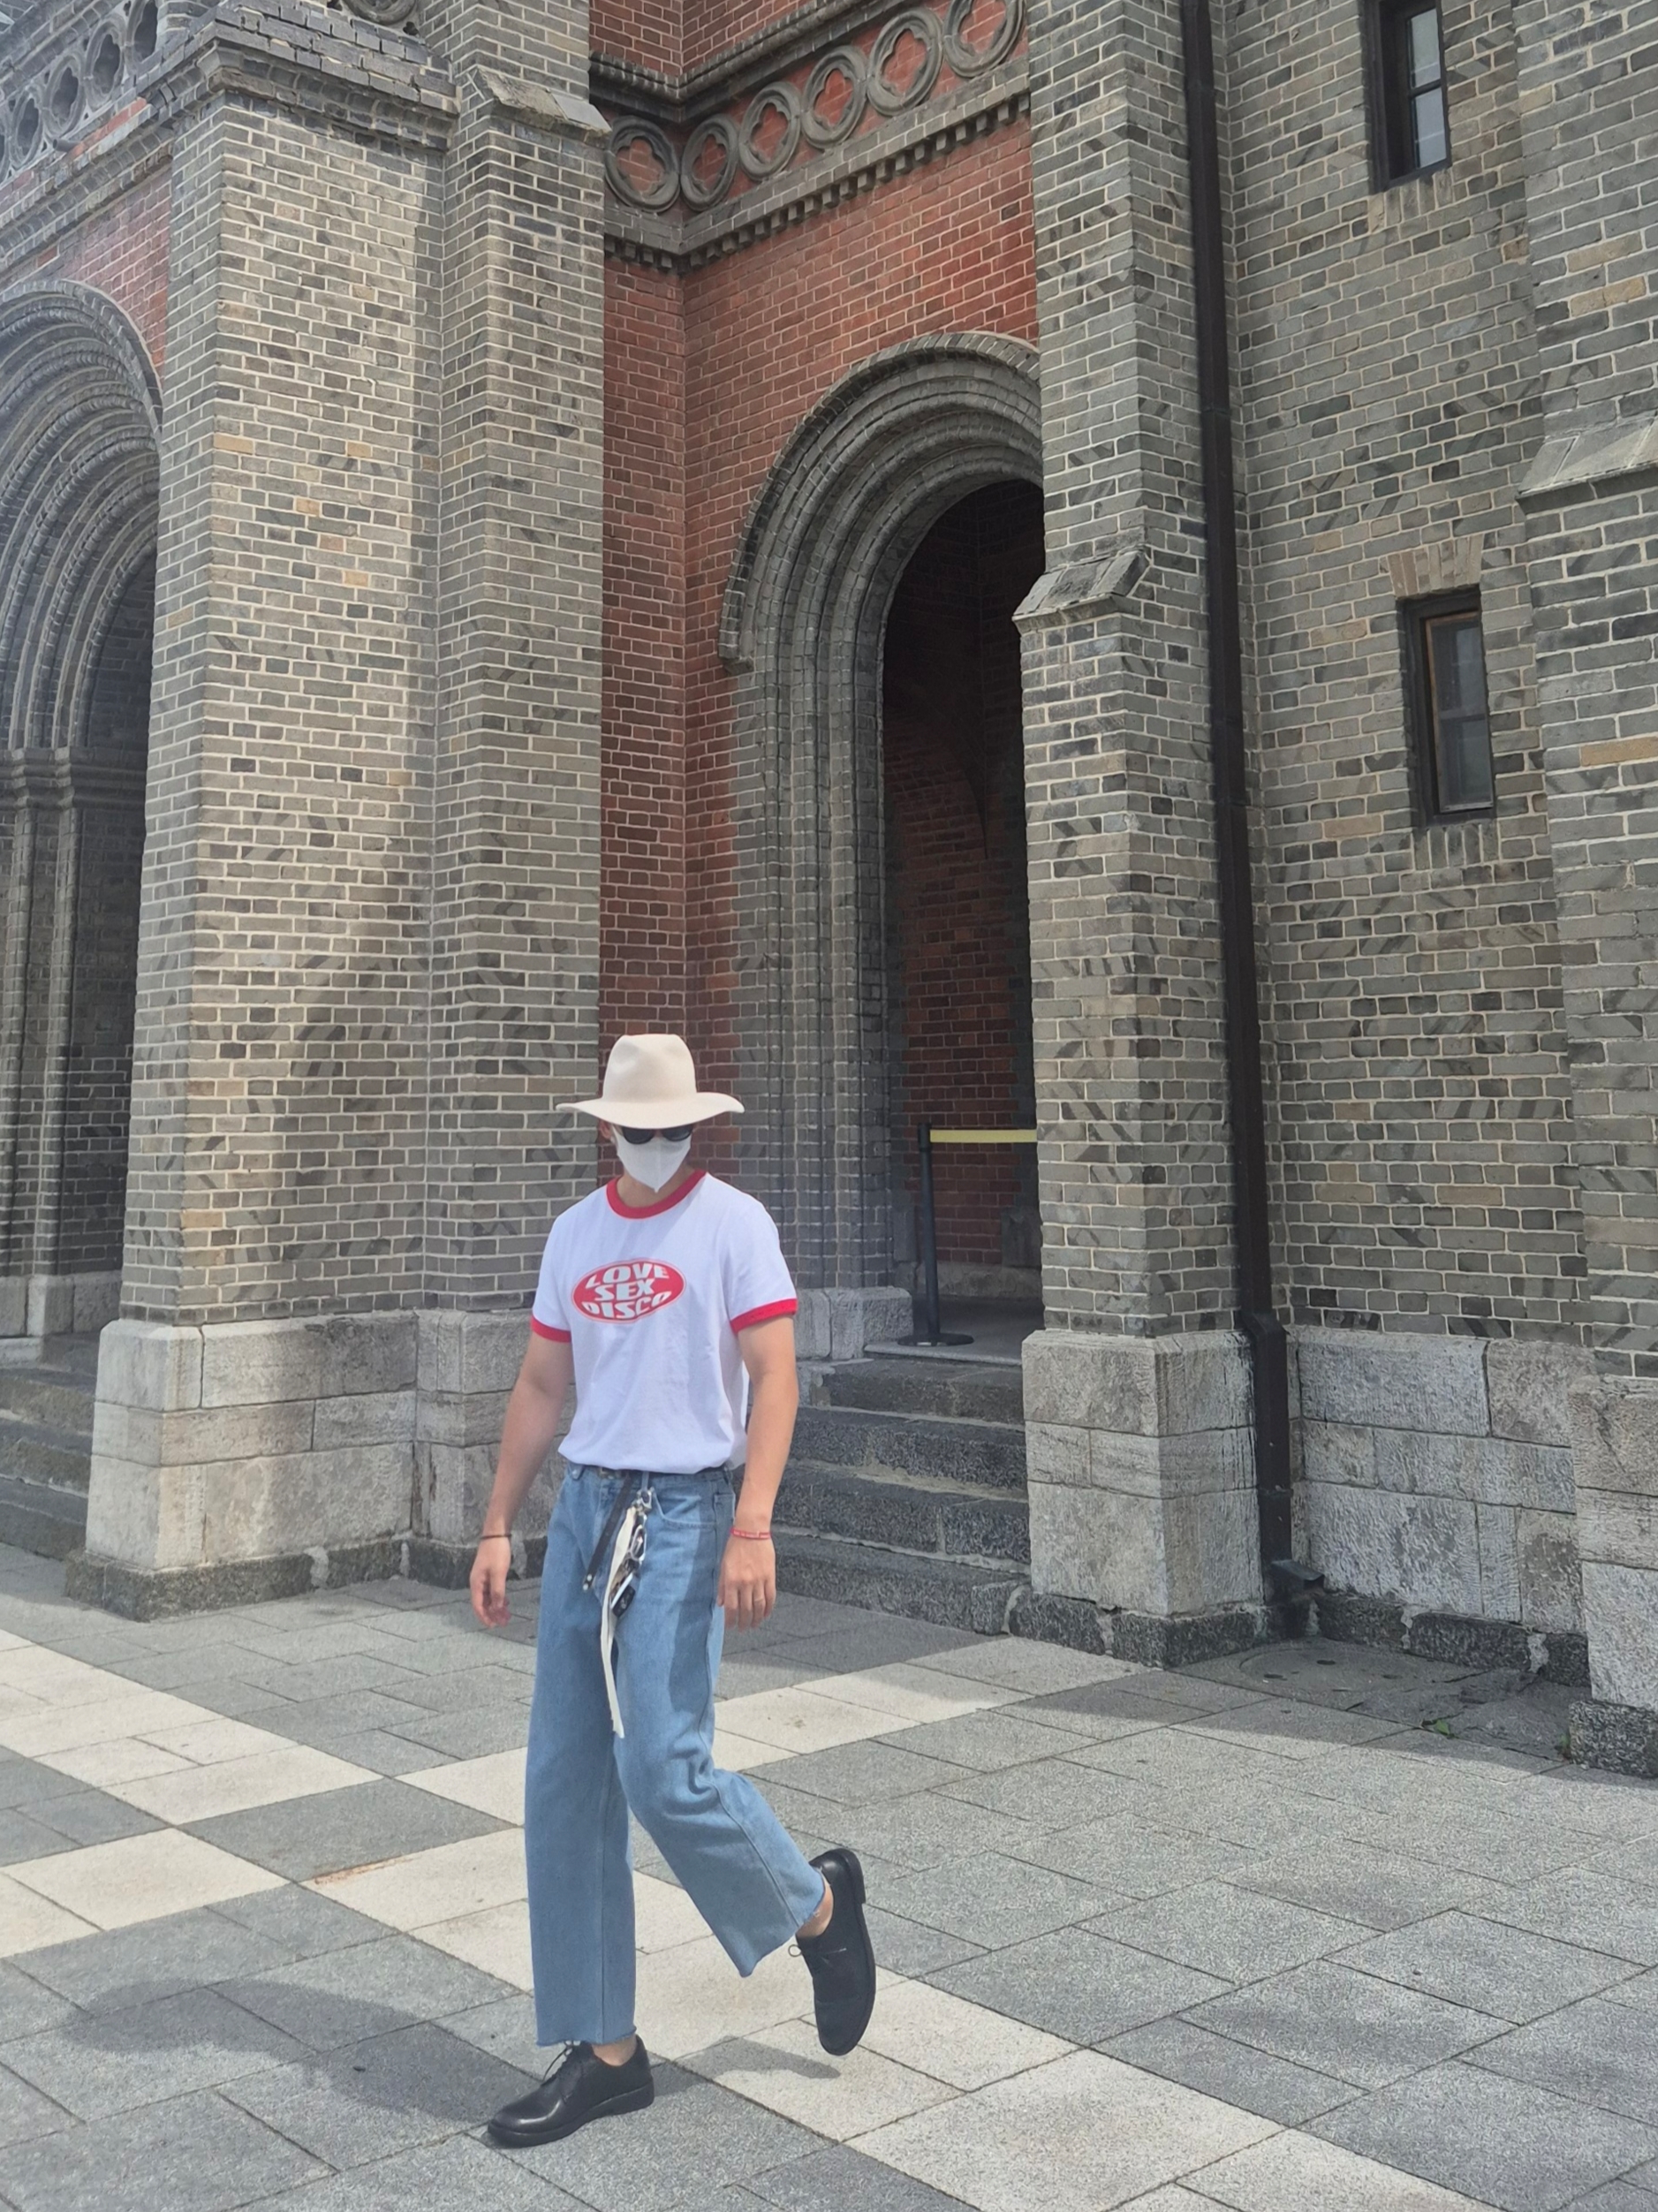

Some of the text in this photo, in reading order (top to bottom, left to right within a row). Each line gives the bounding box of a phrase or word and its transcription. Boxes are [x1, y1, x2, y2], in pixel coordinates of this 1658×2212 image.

[585, 1262, 670, 1289] LOVE
[594, 1278, 655, 1301] SEX
[581, 1291, 672, 1319] DISCO
